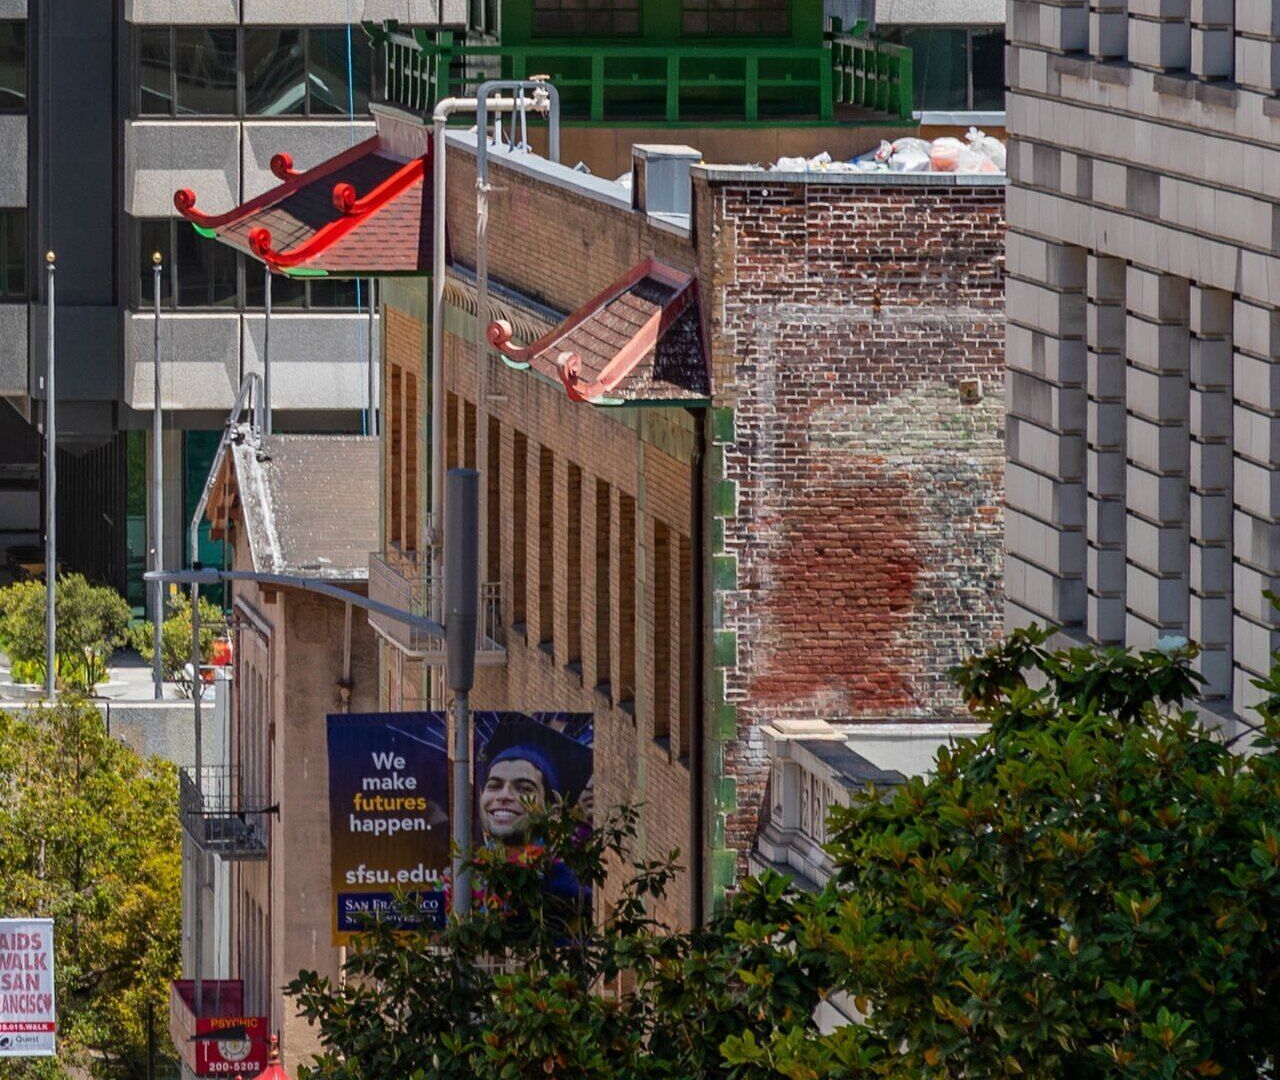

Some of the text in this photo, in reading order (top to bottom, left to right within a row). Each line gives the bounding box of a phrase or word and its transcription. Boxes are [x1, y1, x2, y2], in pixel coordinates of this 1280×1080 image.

[372, 752, 406, 770] We
[362, 772, 417, 790] make
[353, 792, 427, 811] futures
[350, 813, 431, 836] happen.
[345, 863, 438, 885] sfsu.edu
[1, 973, 40, 992] SAN
[210, 1018, 259, 1029] PSYCHIC
[15, 1035, 39, 1044] Quest
